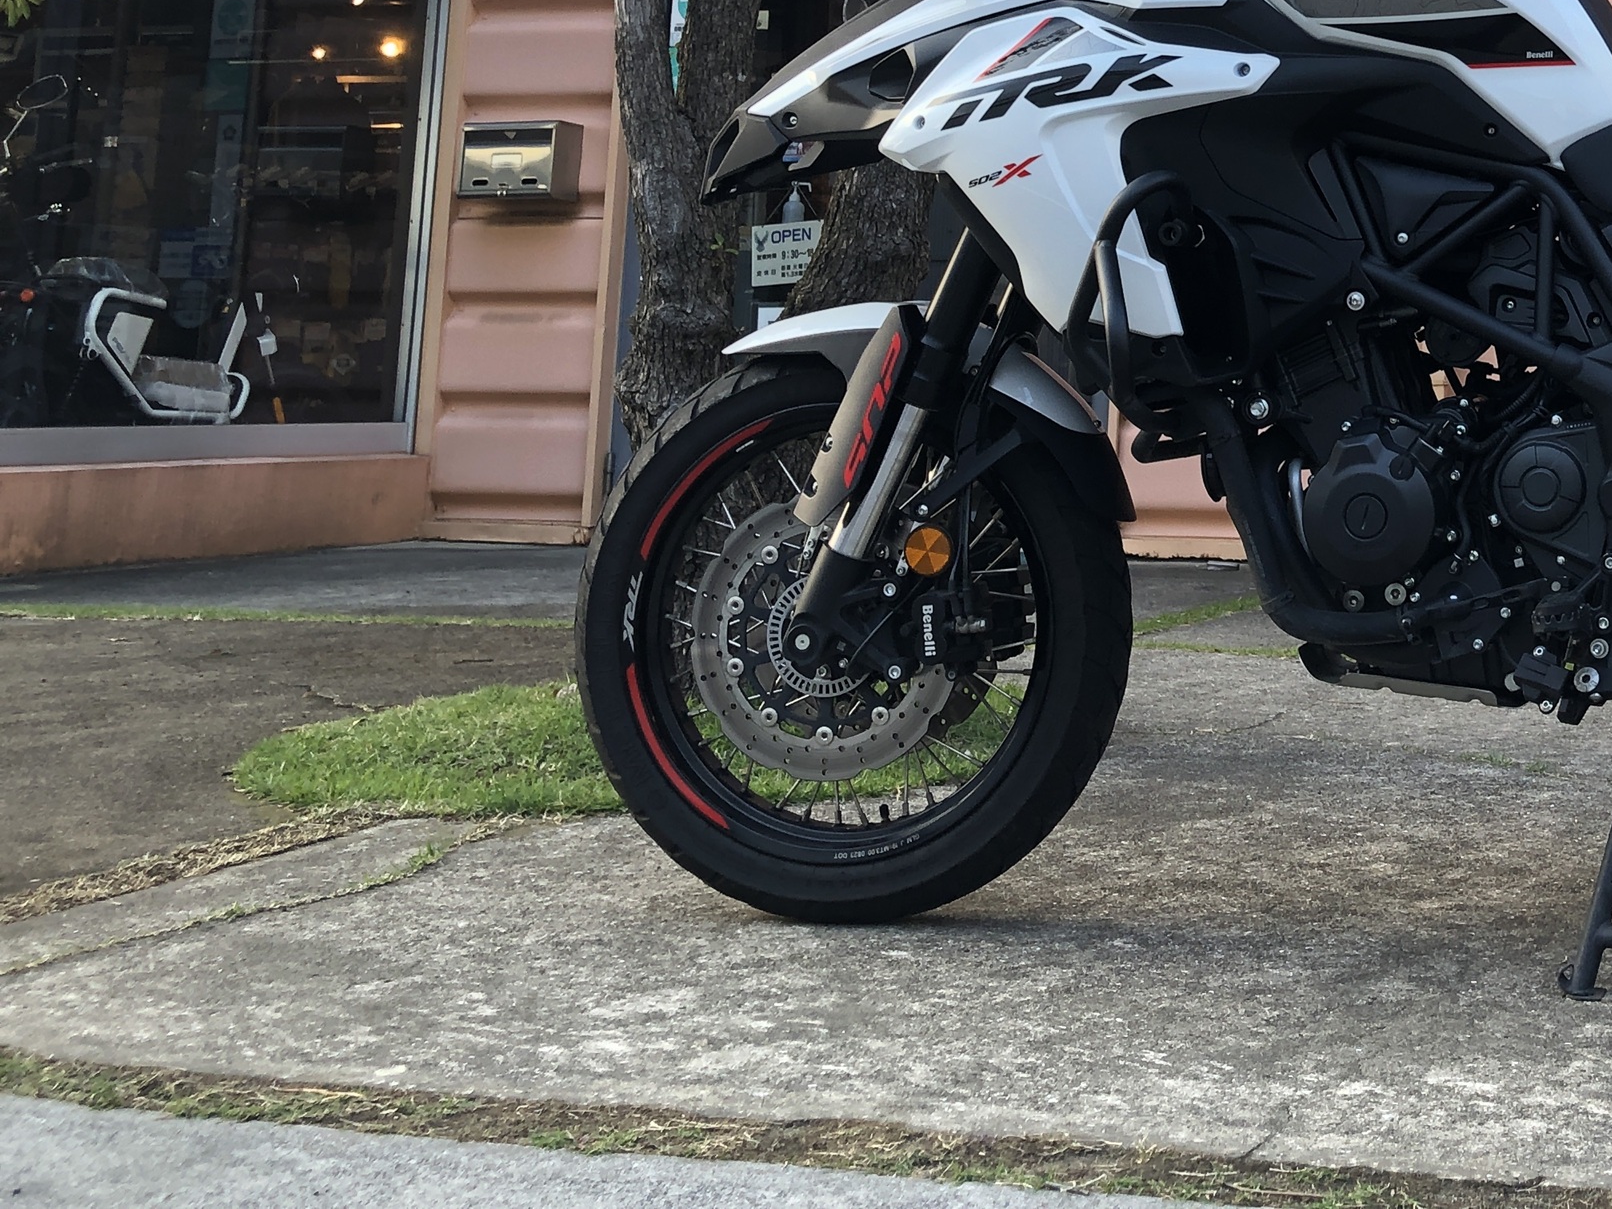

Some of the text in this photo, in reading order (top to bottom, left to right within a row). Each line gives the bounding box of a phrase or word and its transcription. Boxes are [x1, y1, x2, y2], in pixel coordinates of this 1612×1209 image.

[1526, 50, 1554, 59] Benelli
[926, 53, 1184, 131] TRK
[771, 228, 812, 244] OPEN
[622, 571, 643, 653] TRK
[922, 604, 937, 657] Benelli
